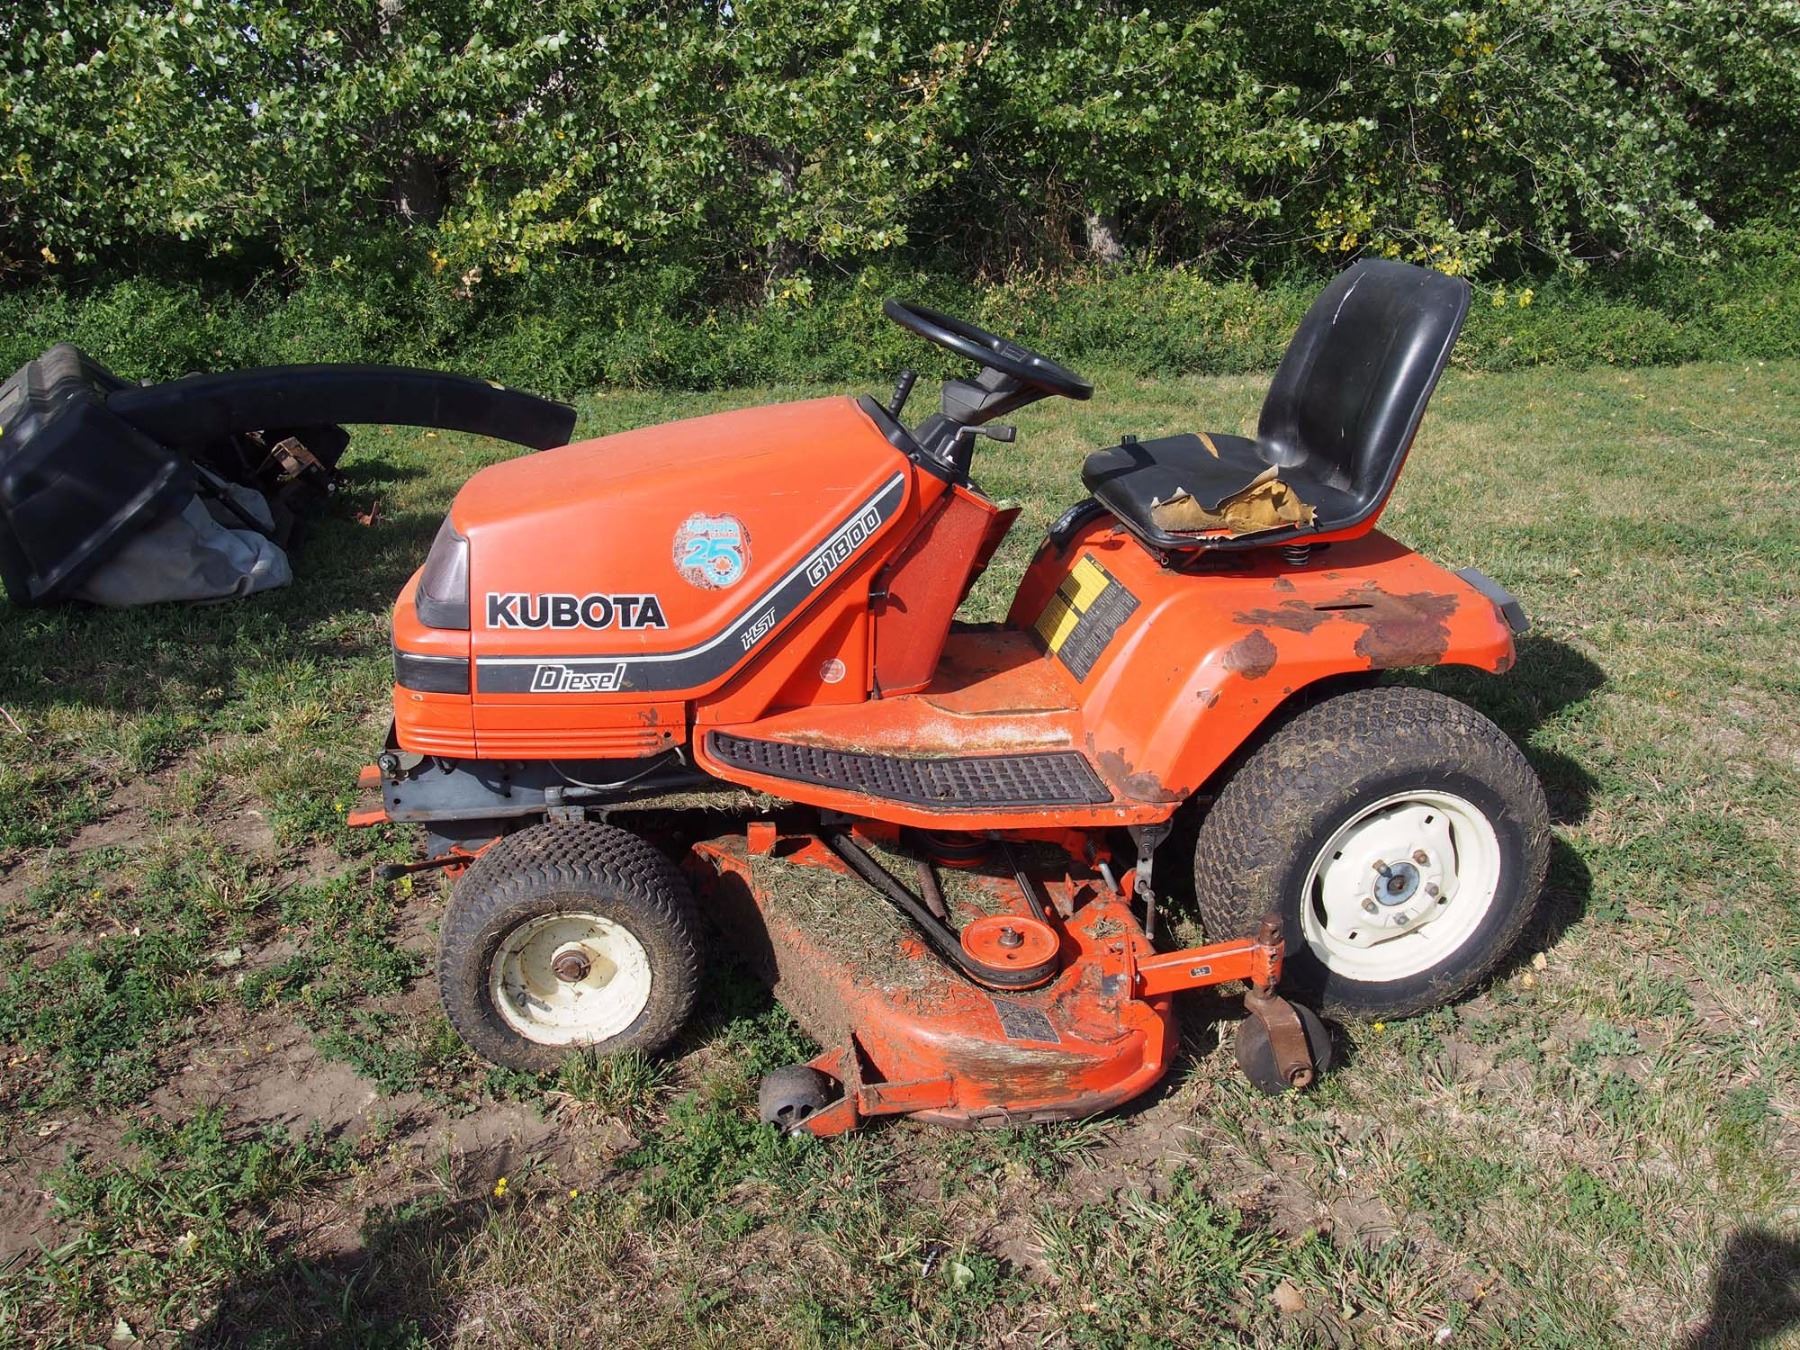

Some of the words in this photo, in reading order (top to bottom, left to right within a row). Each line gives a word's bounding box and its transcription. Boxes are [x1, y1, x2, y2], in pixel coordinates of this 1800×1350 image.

[683, 538, 741, 584] 25
[806, 506, 881, 587] G1800
[486, 592, 669, 630] KUBOTA
[740, 606, 776, 651] HST
[530, 663, 627, 692] Diesel
